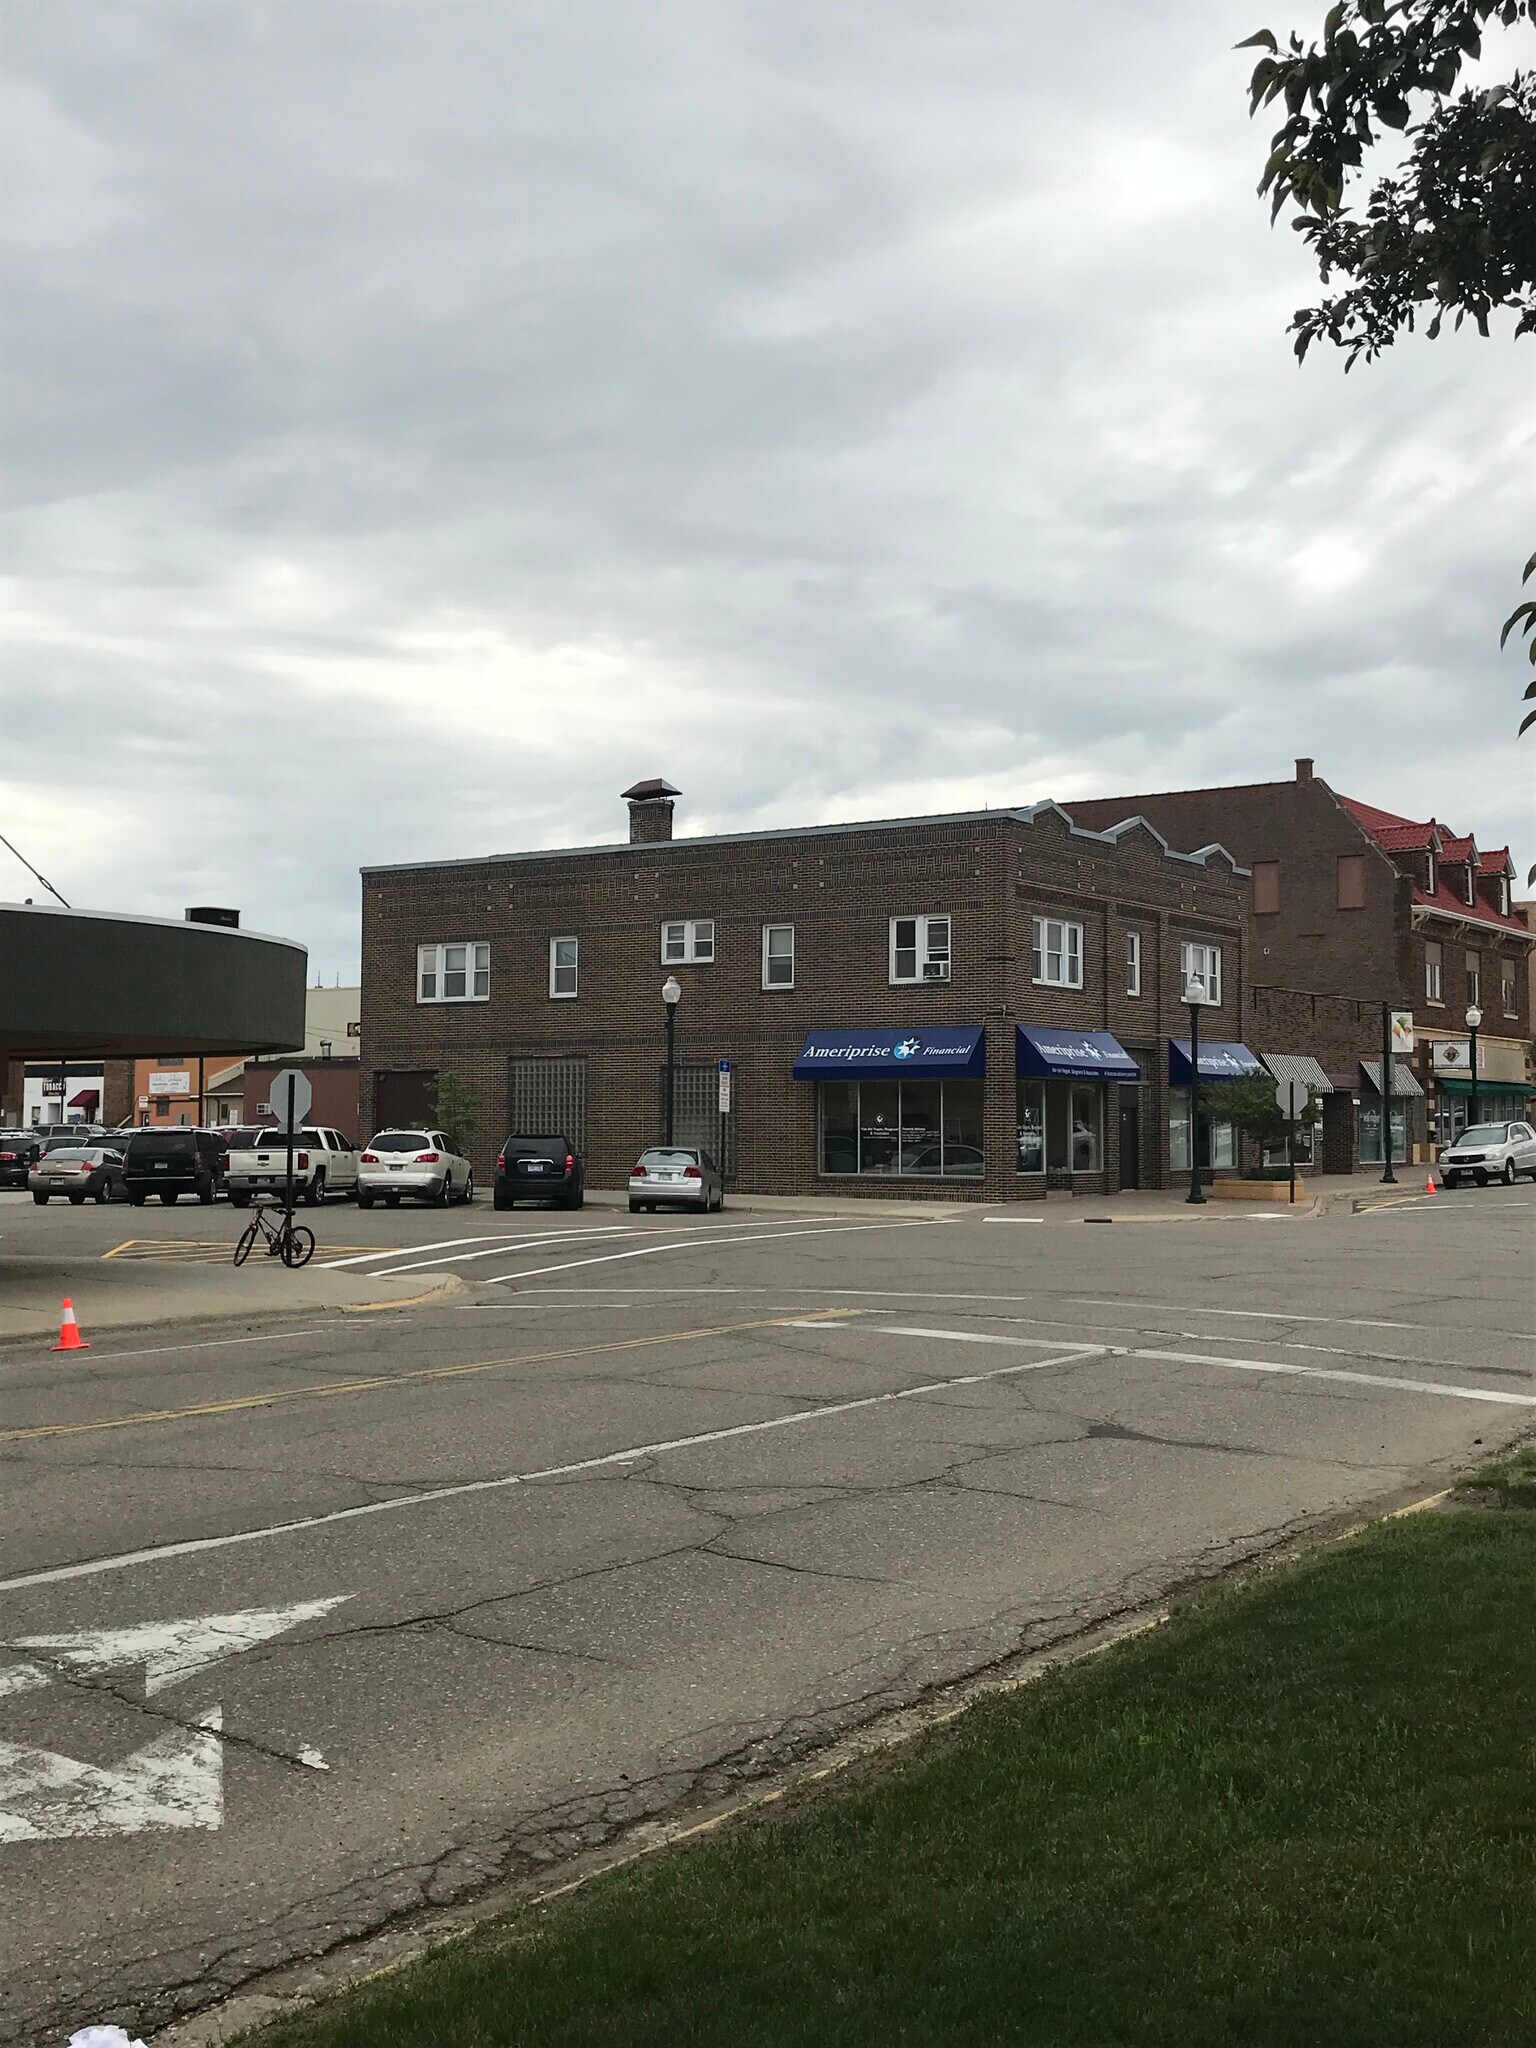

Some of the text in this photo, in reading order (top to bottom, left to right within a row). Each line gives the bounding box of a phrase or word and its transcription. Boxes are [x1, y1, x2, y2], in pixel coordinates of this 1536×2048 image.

[802, 1044, 972, 1061] Ameriprise Financial
[1034, 1041, 1089, 1060] Ameriprise
